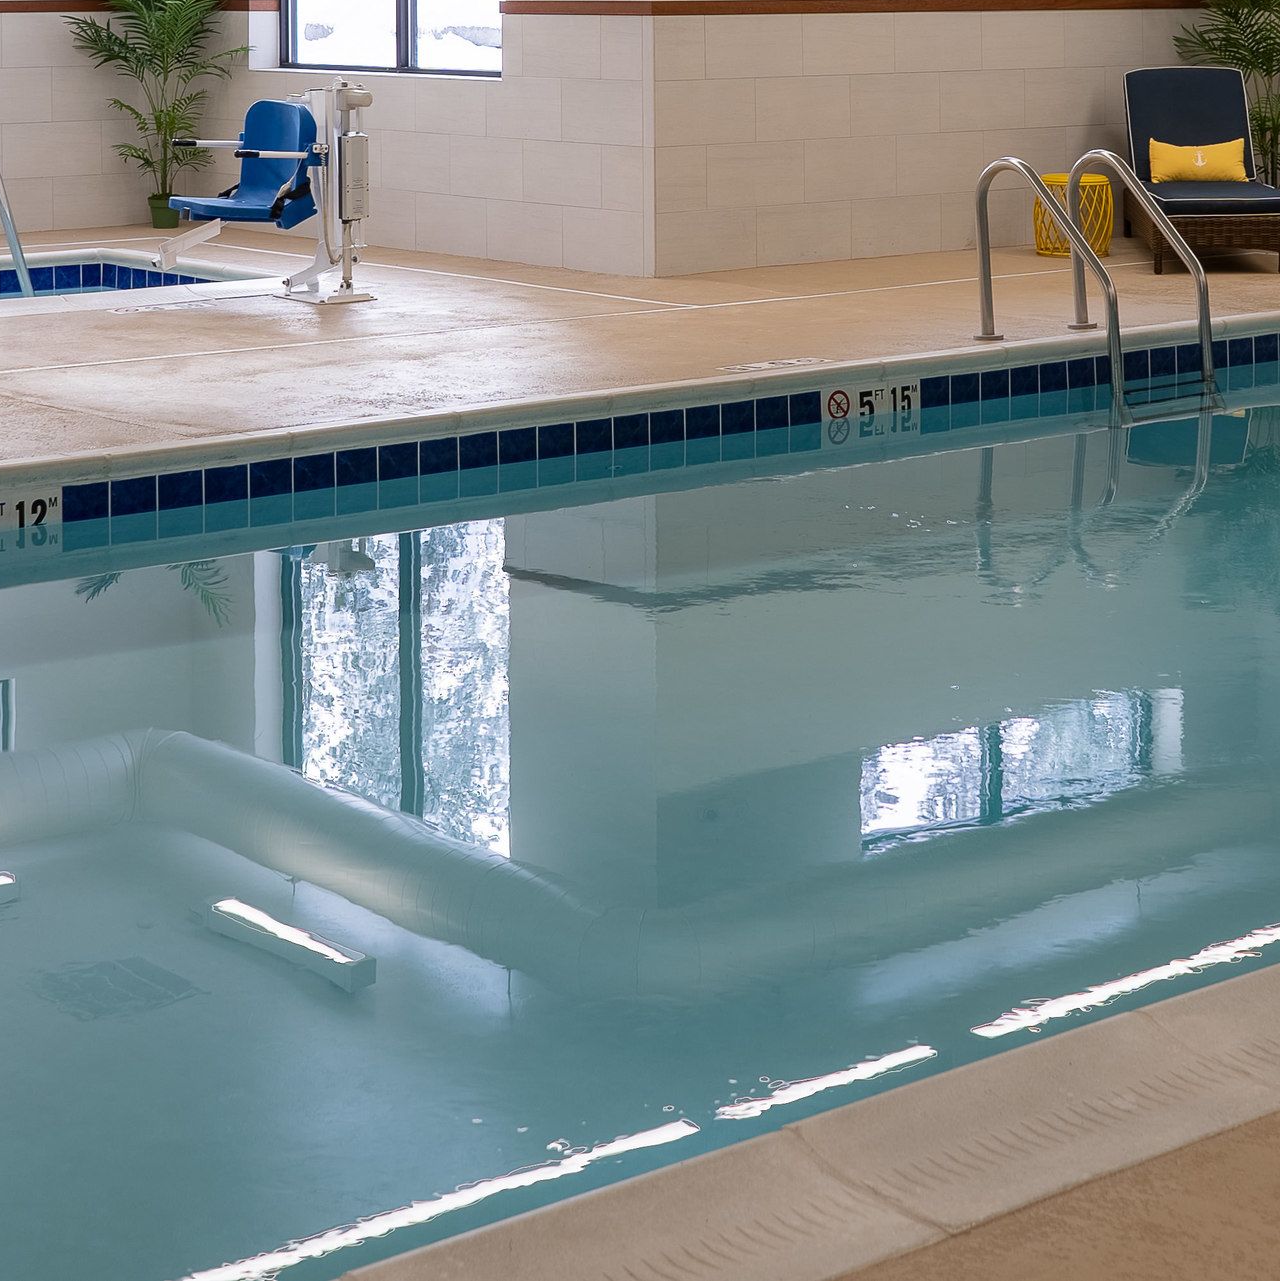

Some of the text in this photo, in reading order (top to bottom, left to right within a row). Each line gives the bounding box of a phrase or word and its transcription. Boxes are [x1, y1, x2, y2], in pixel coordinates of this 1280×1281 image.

[859, 390, 875, 417] 5
[875, 388, 885, 401] FT
[911, 384, 918, 393] M
[48, 496, 58, 508] M
